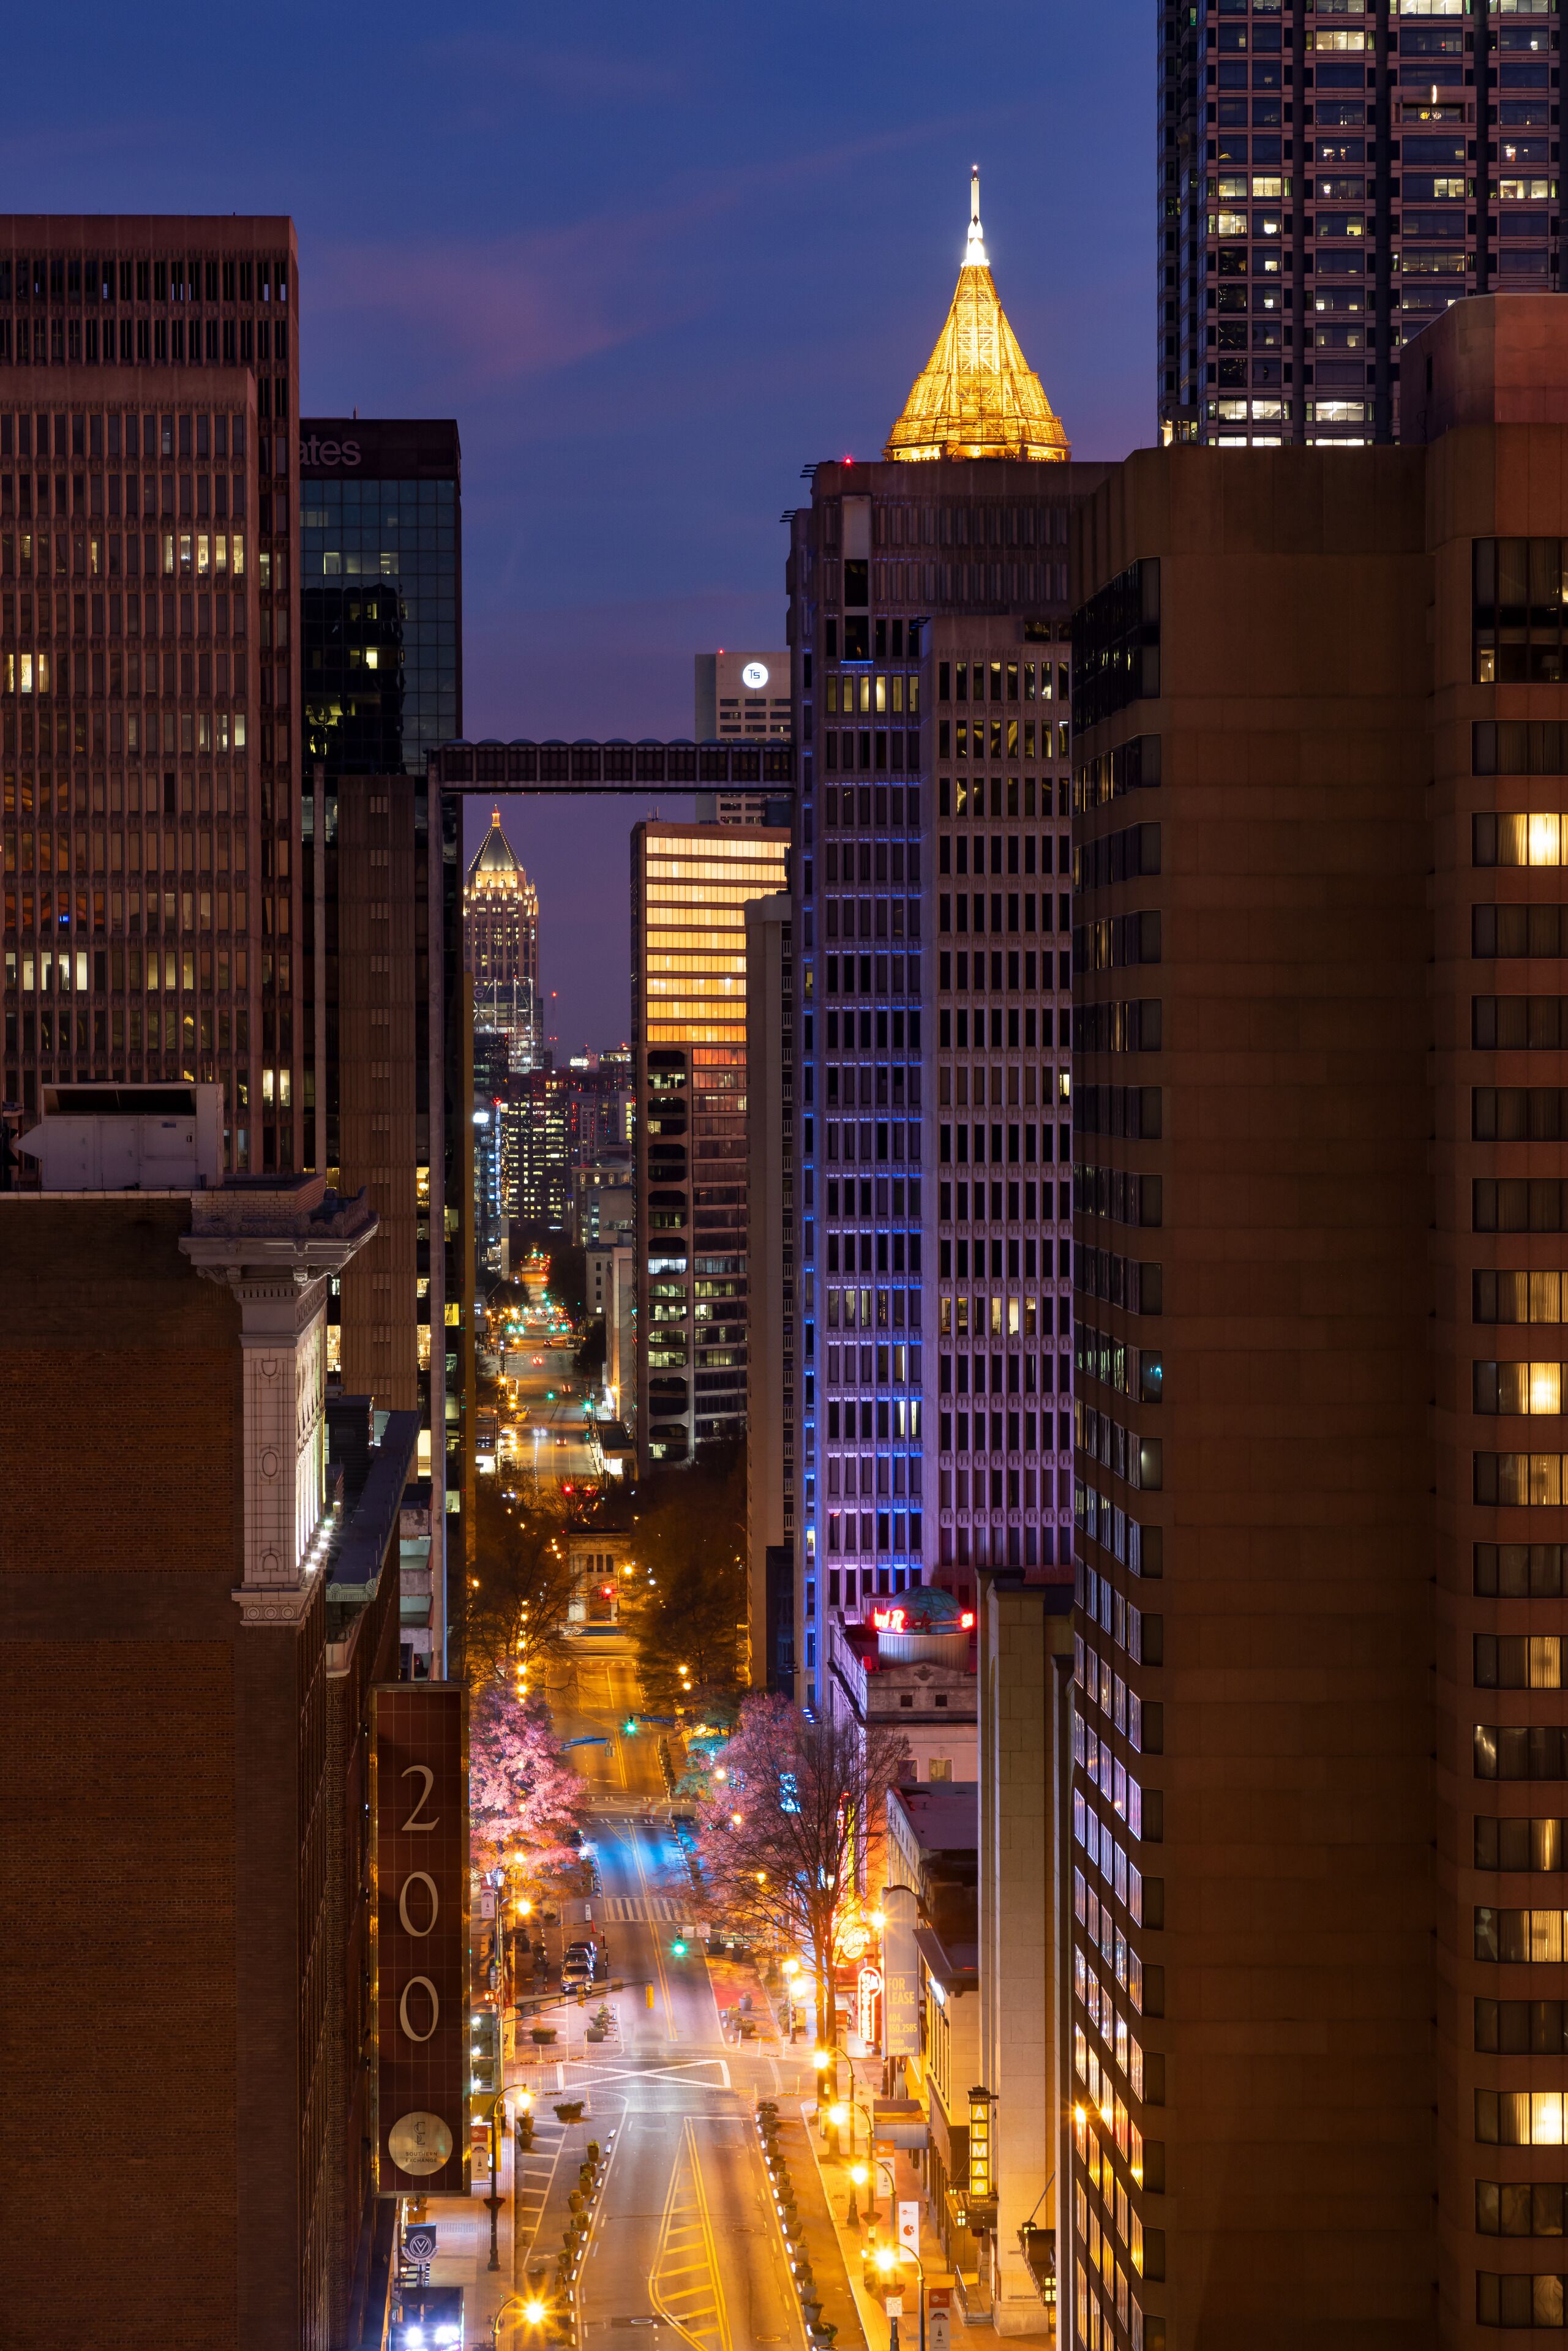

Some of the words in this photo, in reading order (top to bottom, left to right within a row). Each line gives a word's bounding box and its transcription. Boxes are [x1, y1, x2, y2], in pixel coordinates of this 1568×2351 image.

[888, 1978, 906, 1990] FOR
[888, 1991, 915, 2005] LEASE
[861, 1973, 871, 2039] HOOTERS
[973, 2105, 986, 2175] ALMA
